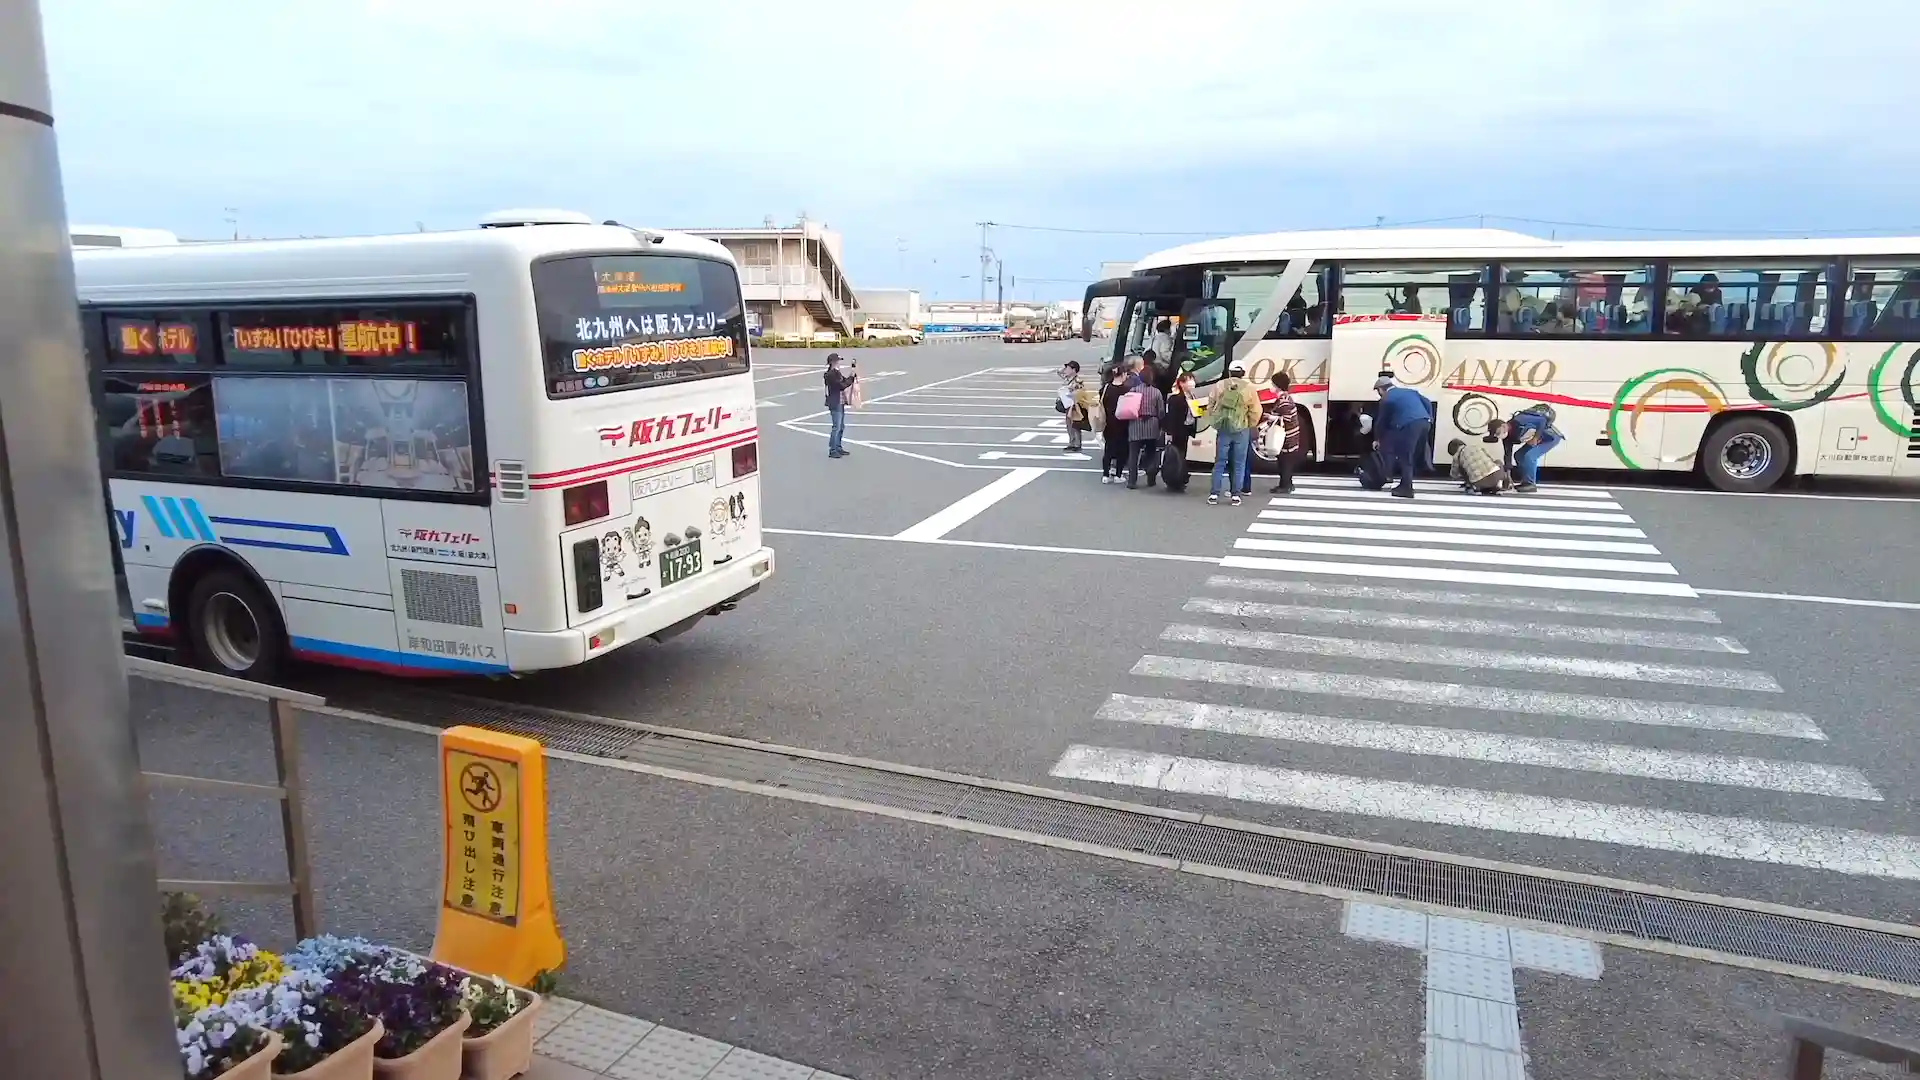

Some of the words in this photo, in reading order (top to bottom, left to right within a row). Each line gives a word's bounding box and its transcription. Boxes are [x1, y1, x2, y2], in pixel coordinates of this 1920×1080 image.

[575, 312, 727, 341] 北九州へは阪九フェリー
[653, 369, 678, 380] ISUZU
[1249, 358, 1329, 385] OKA
[1441, 358, 1557, 387] ANKO
[628, 406, 732, 447] 阪九フェリー
[414, 529, 480, 544] 阪九フェリー
[669, 551, 701, 582] 17-93
[408, 636, 497, 659] 岸和田観光バス
[461, 813, 476, 908] 飛び出し注意
[490, 820, 505, 916] 車両通行注意
